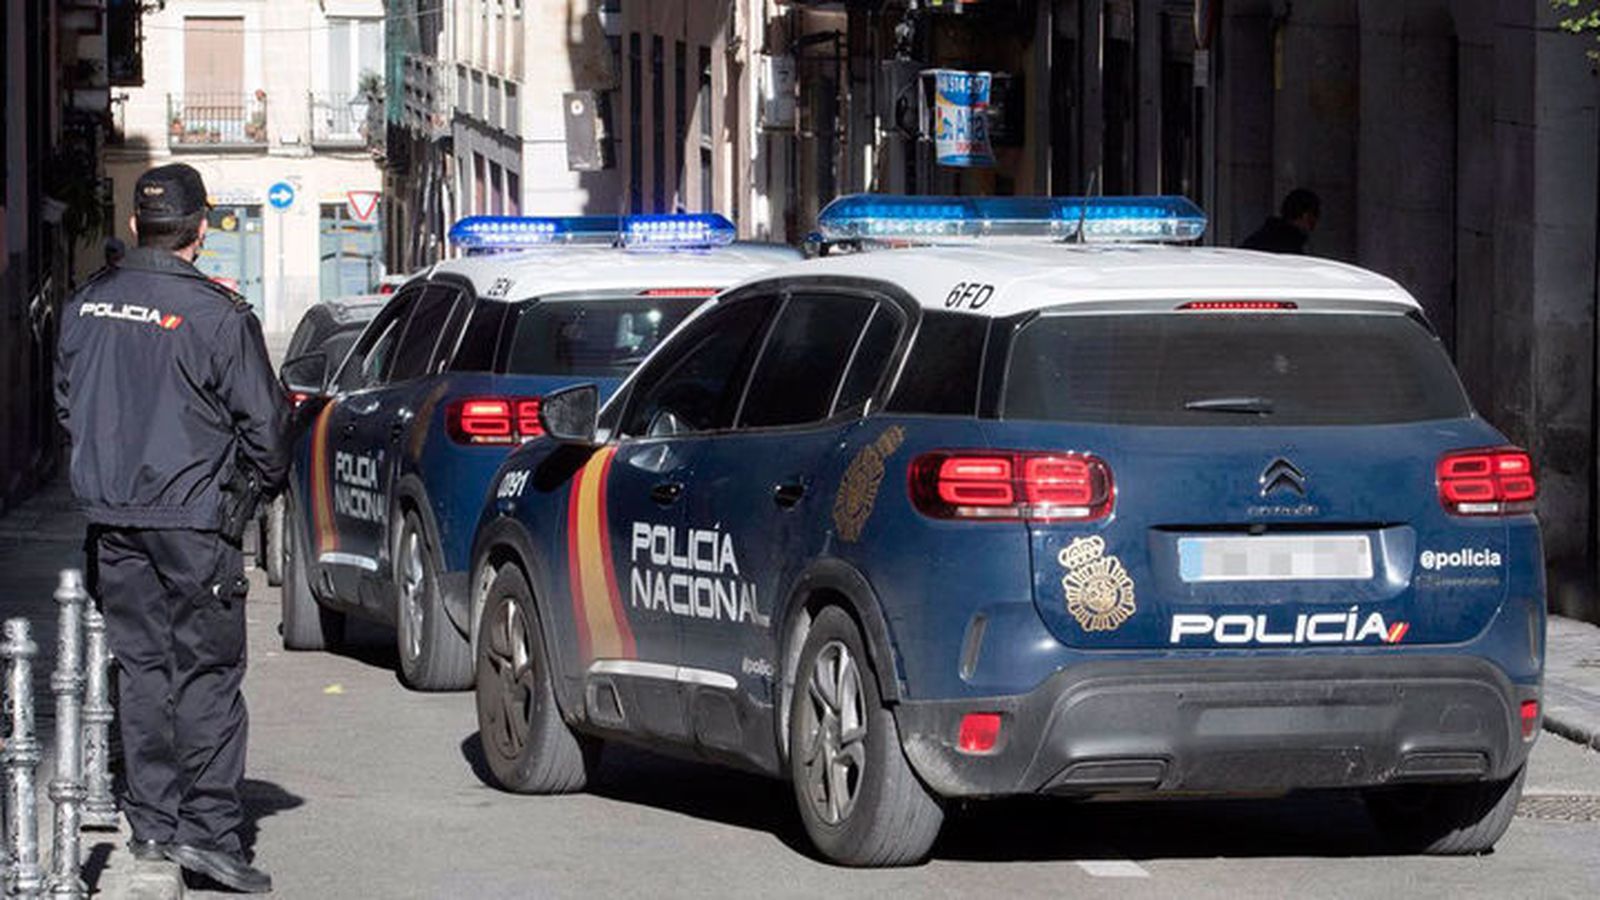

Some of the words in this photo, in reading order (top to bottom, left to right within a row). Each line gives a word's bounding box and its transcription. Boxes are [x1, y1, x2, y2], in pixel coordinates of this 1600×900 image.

[945, 282, 995, 309] 6FD
[631, 521, 739, 576] POLICÍA
[1420, 548, 1502, 571] @policia
[631, 566, 771, 628] NACIONAL
[1170, 605, 1389, 644] POLICÍA
